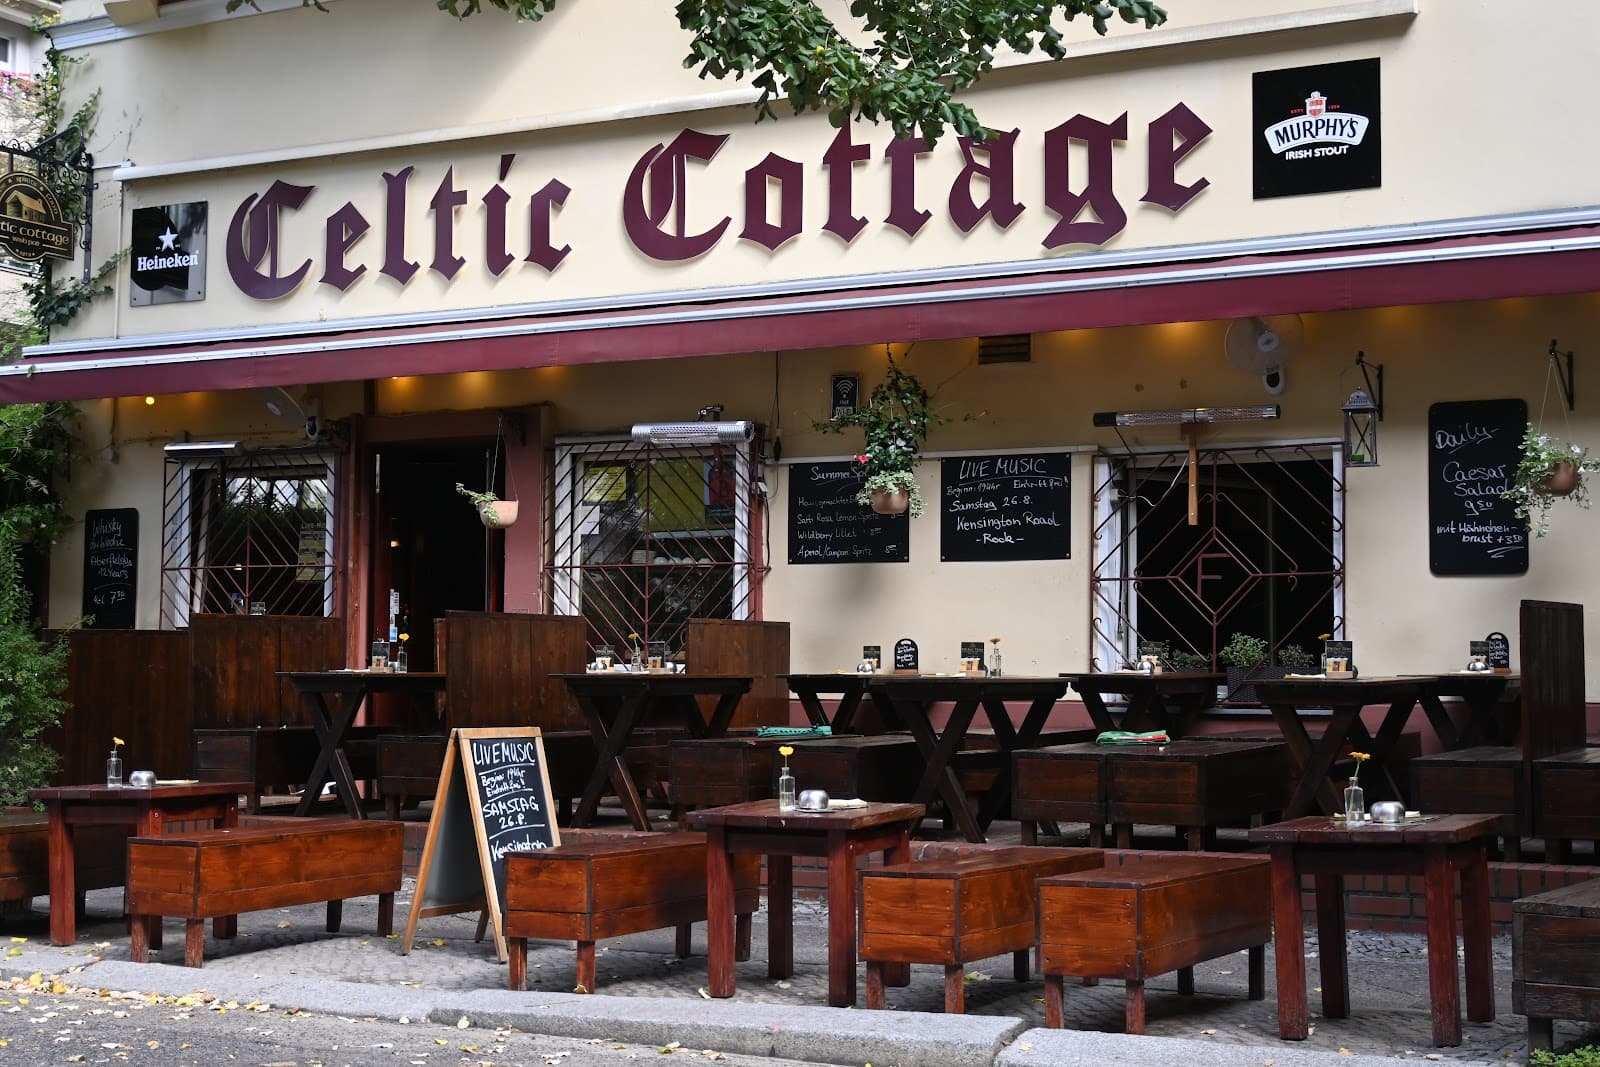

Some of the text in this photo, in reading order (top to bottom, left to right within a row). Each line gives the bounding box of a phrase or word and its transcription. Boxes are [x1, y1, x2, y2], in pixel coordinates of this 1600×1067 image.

[1274, 117, 1359, 147] MURPHY'S
[1285, 145, 1350, 160] IRISH STOUT
[225, 101, 1213, 300] Celtic Cottage
[0, 220, 70, 246] tic cottage
[137, 253, 198, 272] Heineken
[810, 466, 850, 481] Summer
[960, 458, 1047, 480] LIVE MUSIC
[1442, 461, 1507, 483] Caesar
[1454, 479, 1509, 497] Salad
[949, 500, 998, 512] Samstag
[957, 511, 1061, 531] Kensington Road
[1437, 521, 1456, 534] mit
[1462, 534, 1493, 544] brust
[482, 795, 540, 818] SAMSTAG
